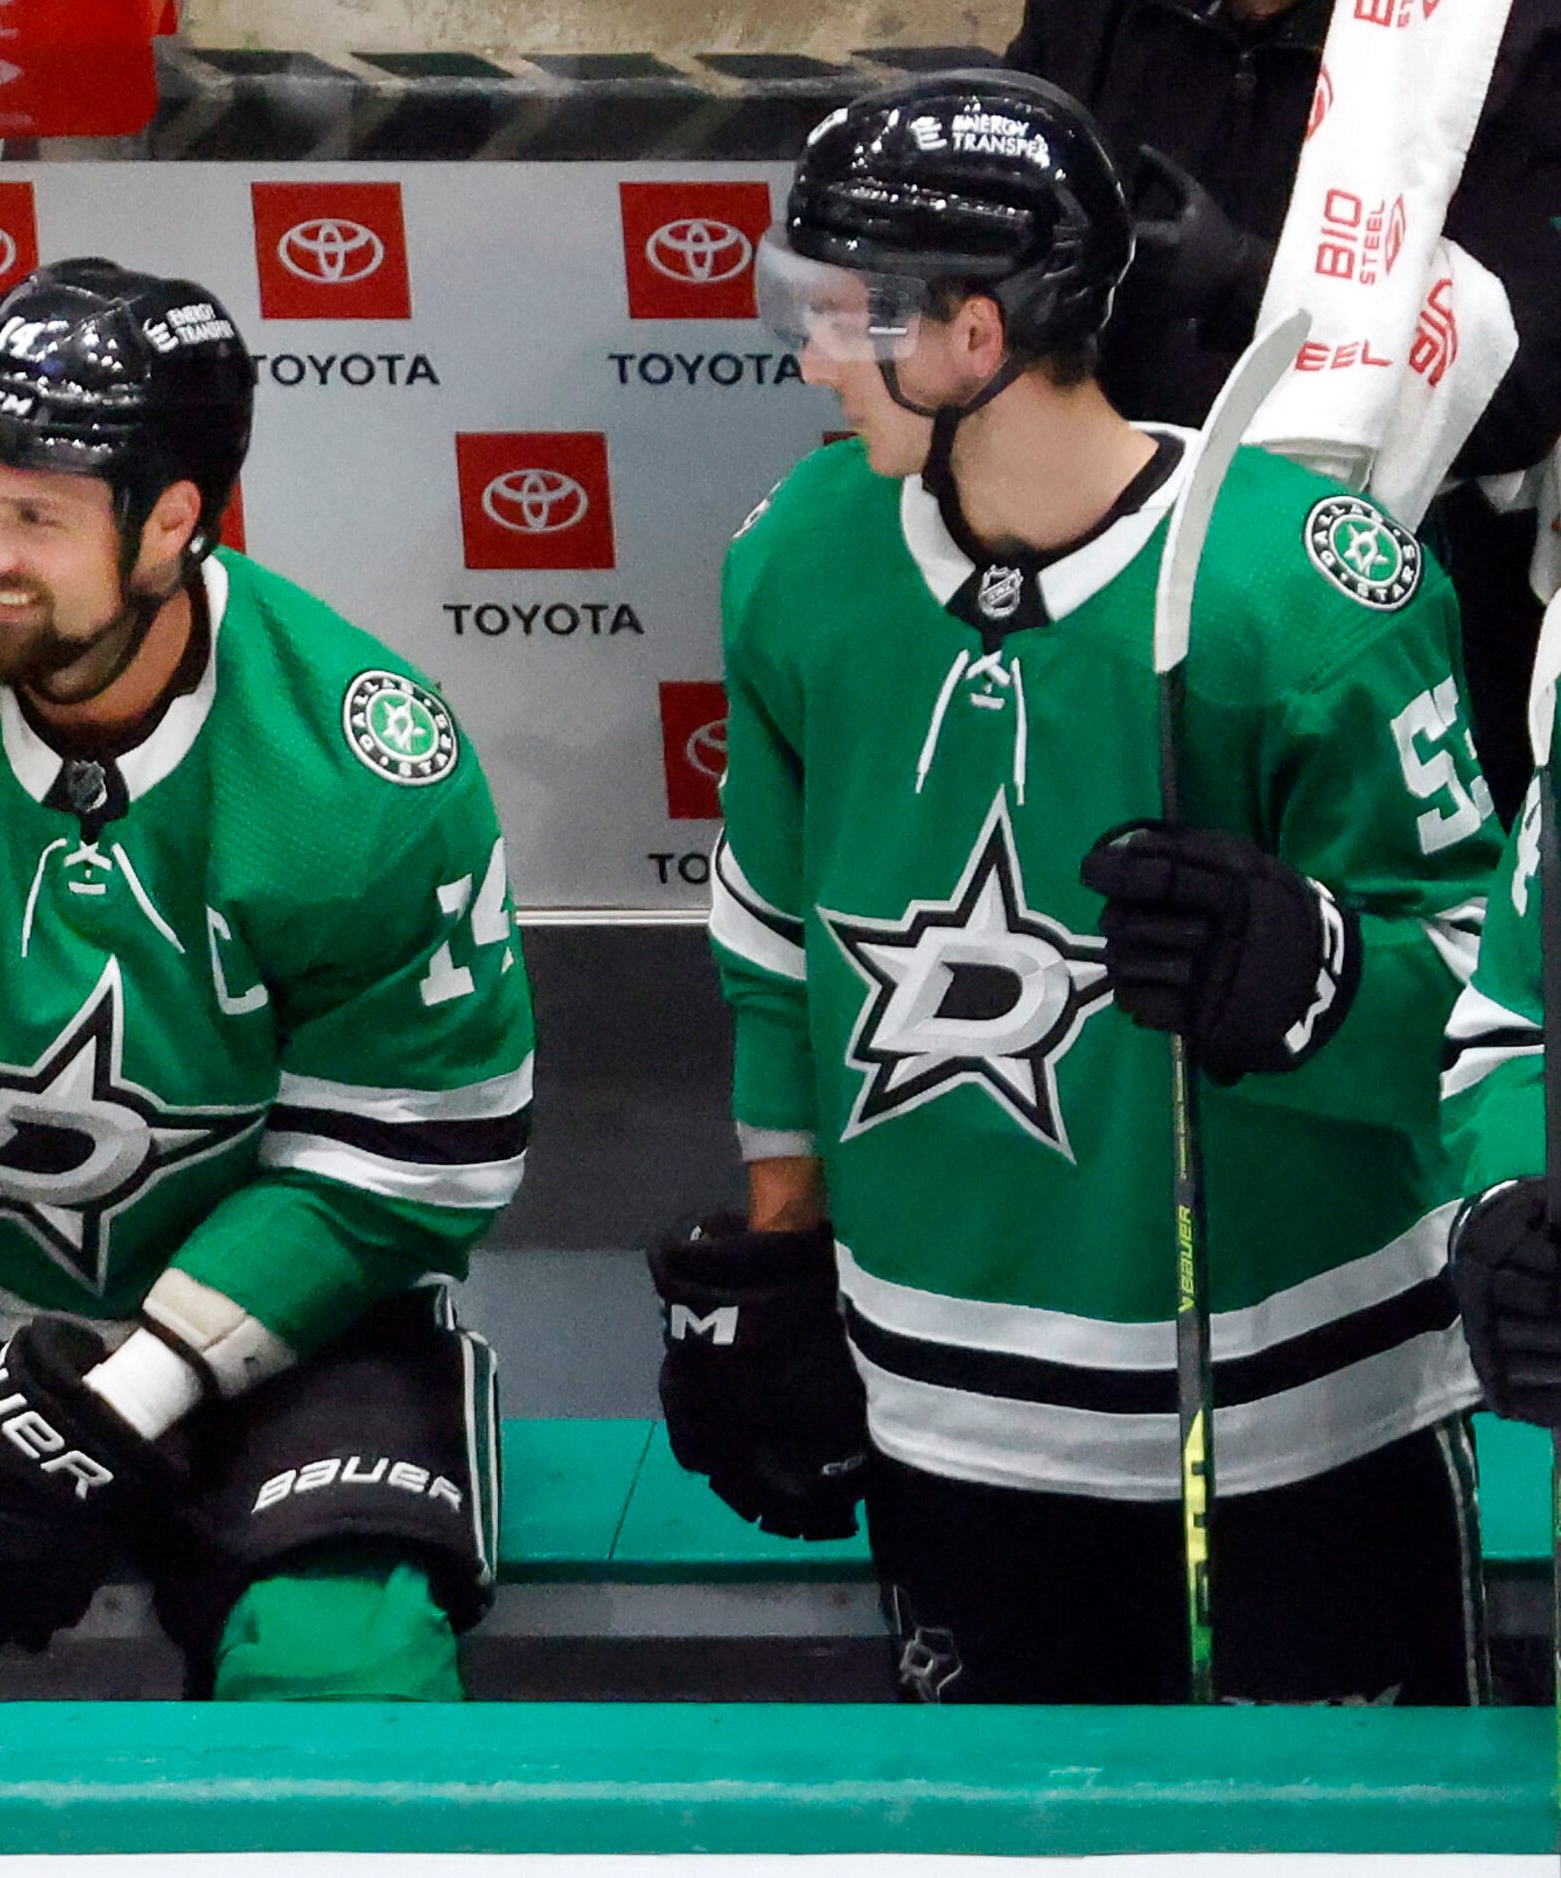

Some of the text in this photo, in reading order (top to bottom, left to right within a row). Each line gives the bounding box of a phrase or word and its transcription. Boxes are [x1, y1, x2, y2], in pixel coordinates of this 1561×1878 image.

[952, 114, 1031, 138] ENERGY
[1315, 188, 1362, 280] BIO
[1359, 198, 1386, 286] STEEL
[249, 353, 440, 387] TOYOTA
[608, 352, 805, 387] TOYOTA
[1295, 340, 1394, 372] EEL
[442, 603, 645, 637] TOYOTA
[204, 902, 269, 1016] C
[251, 1456, 462, 1513] BAUER
